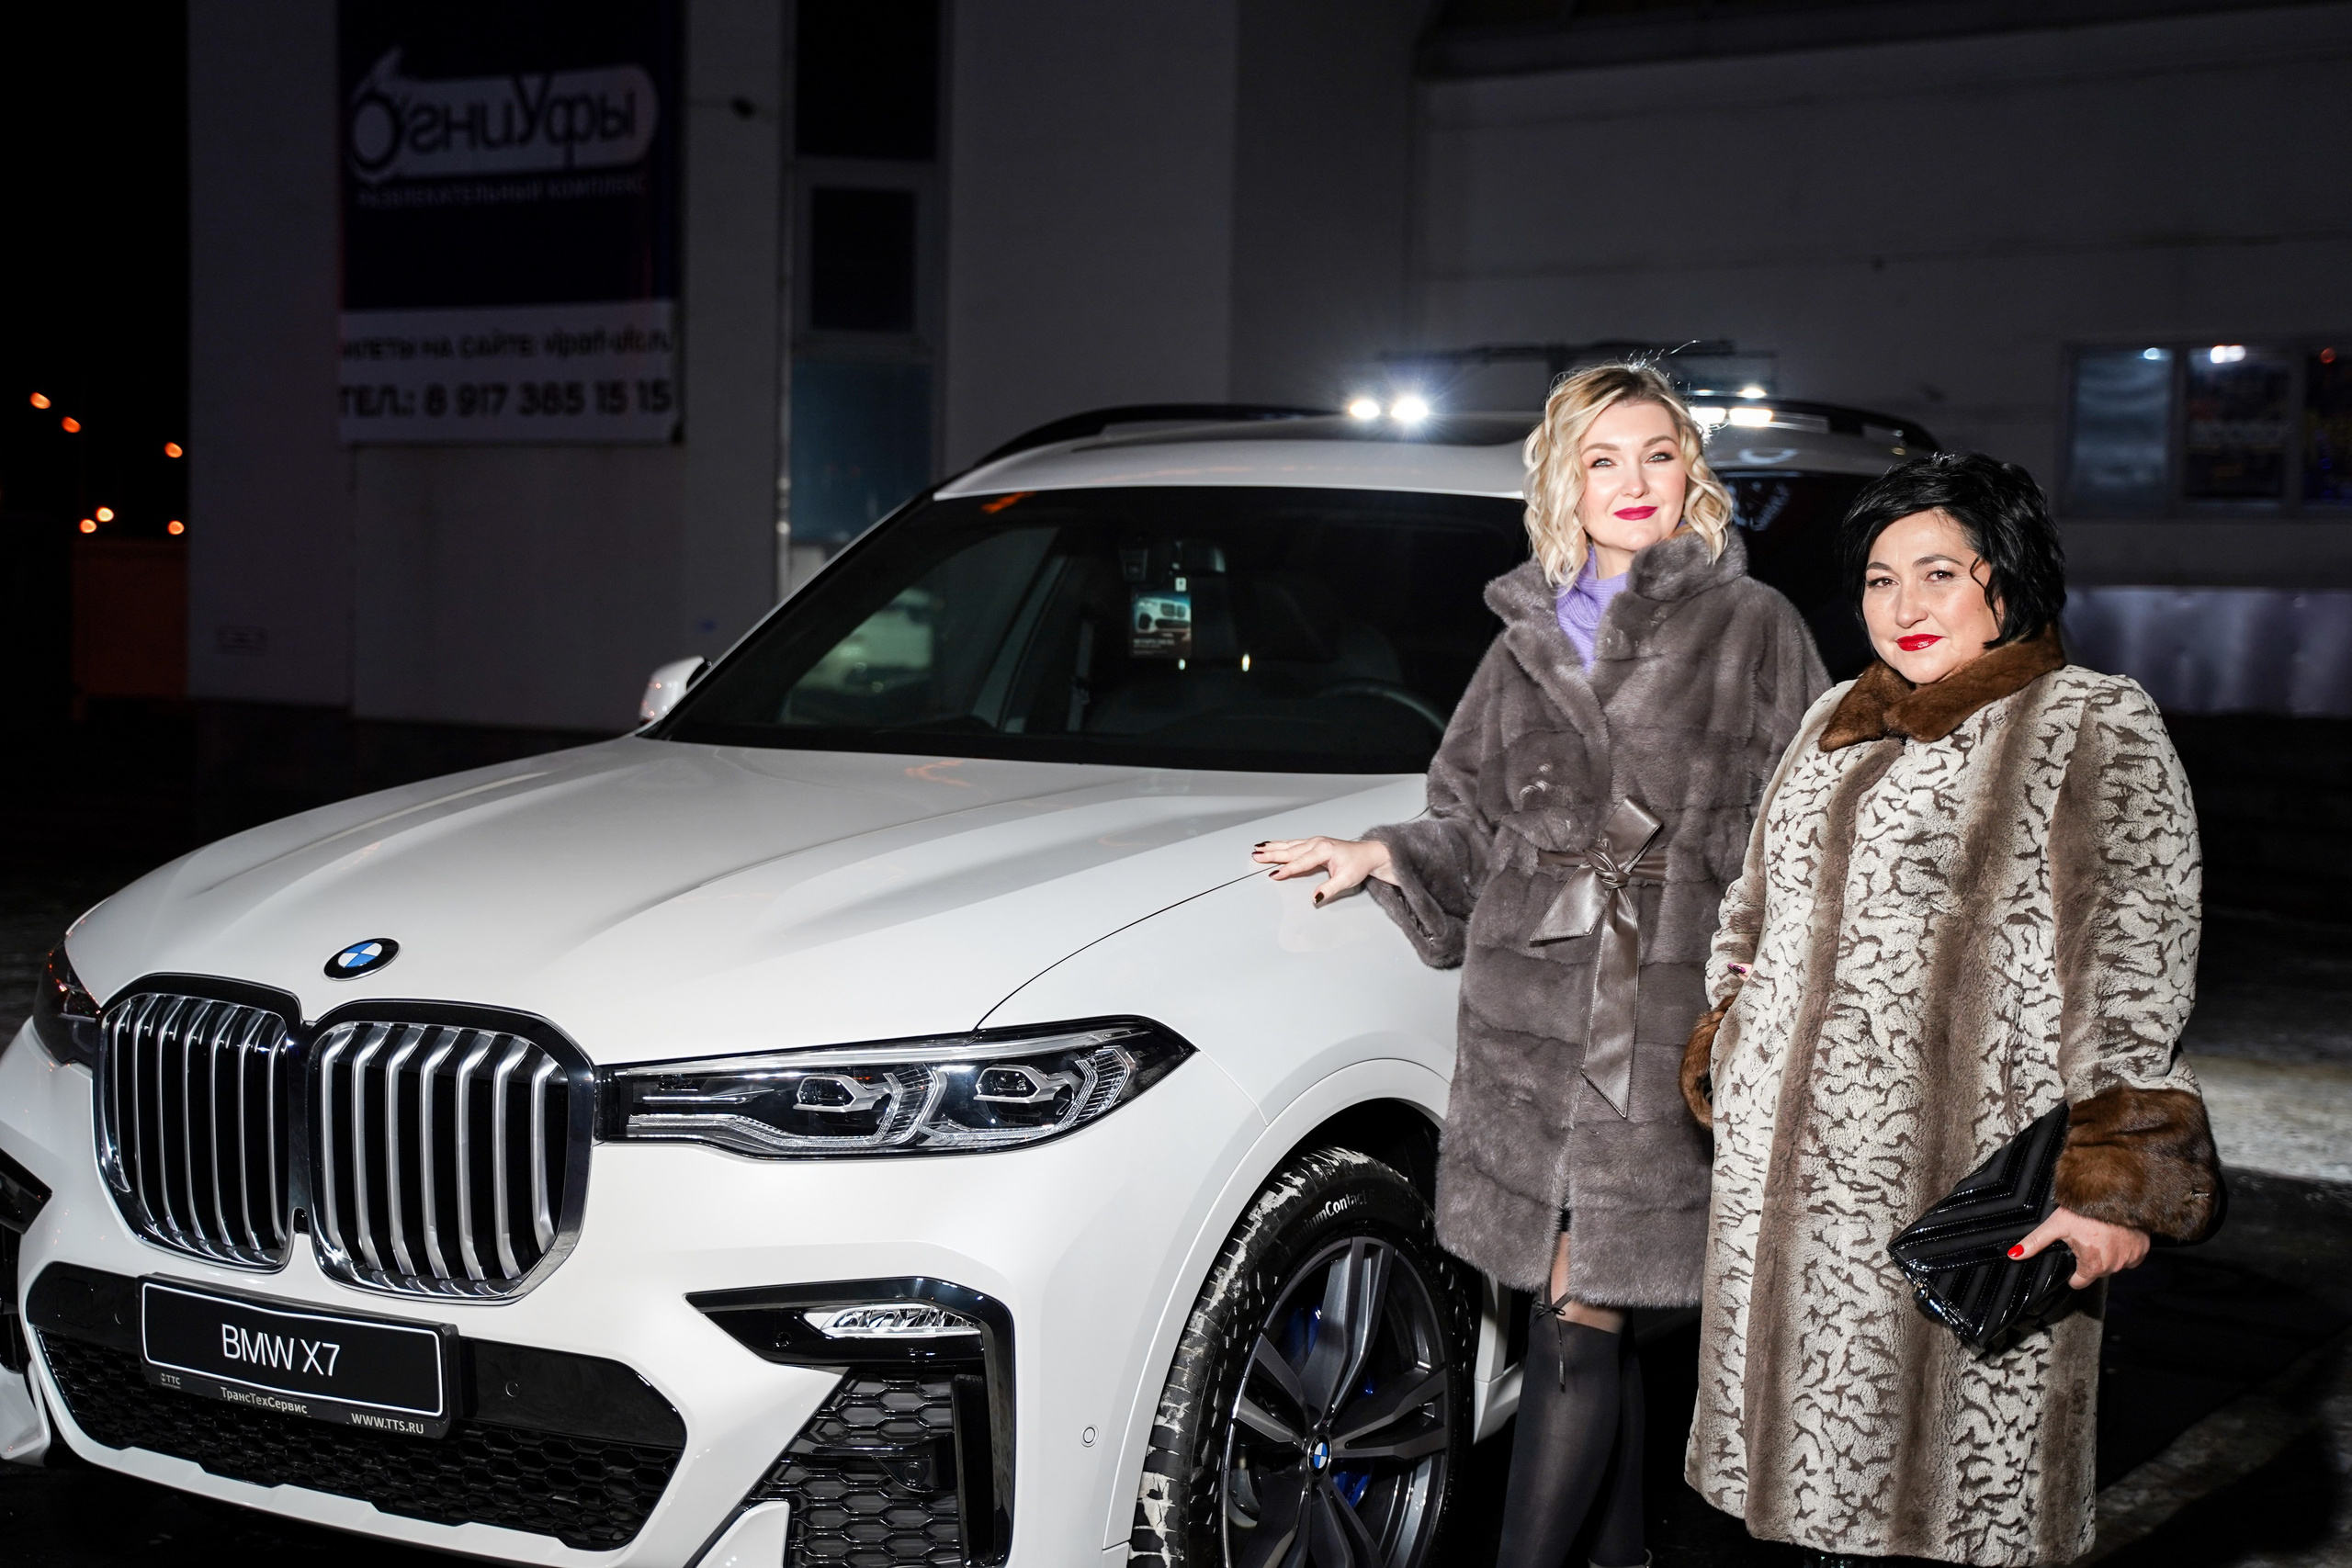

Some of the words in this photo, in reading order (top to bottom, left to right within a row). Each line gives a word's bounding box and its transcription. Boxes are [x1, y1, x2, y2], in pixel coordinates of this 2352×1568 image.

[424, 382, 447, 418] 8
[457, 381, 509, 418] 917
[597, 379, 628, 415] 15
[637, 378, 672, 413] 15
[221, 1323, 295, 1371] BMW
[300, 1338, 340, 1376] X7
[220, 1386, 308, 1415] ТрансТехСервис
[351, 1413, 424, 1434] WWW.TTS.RU
